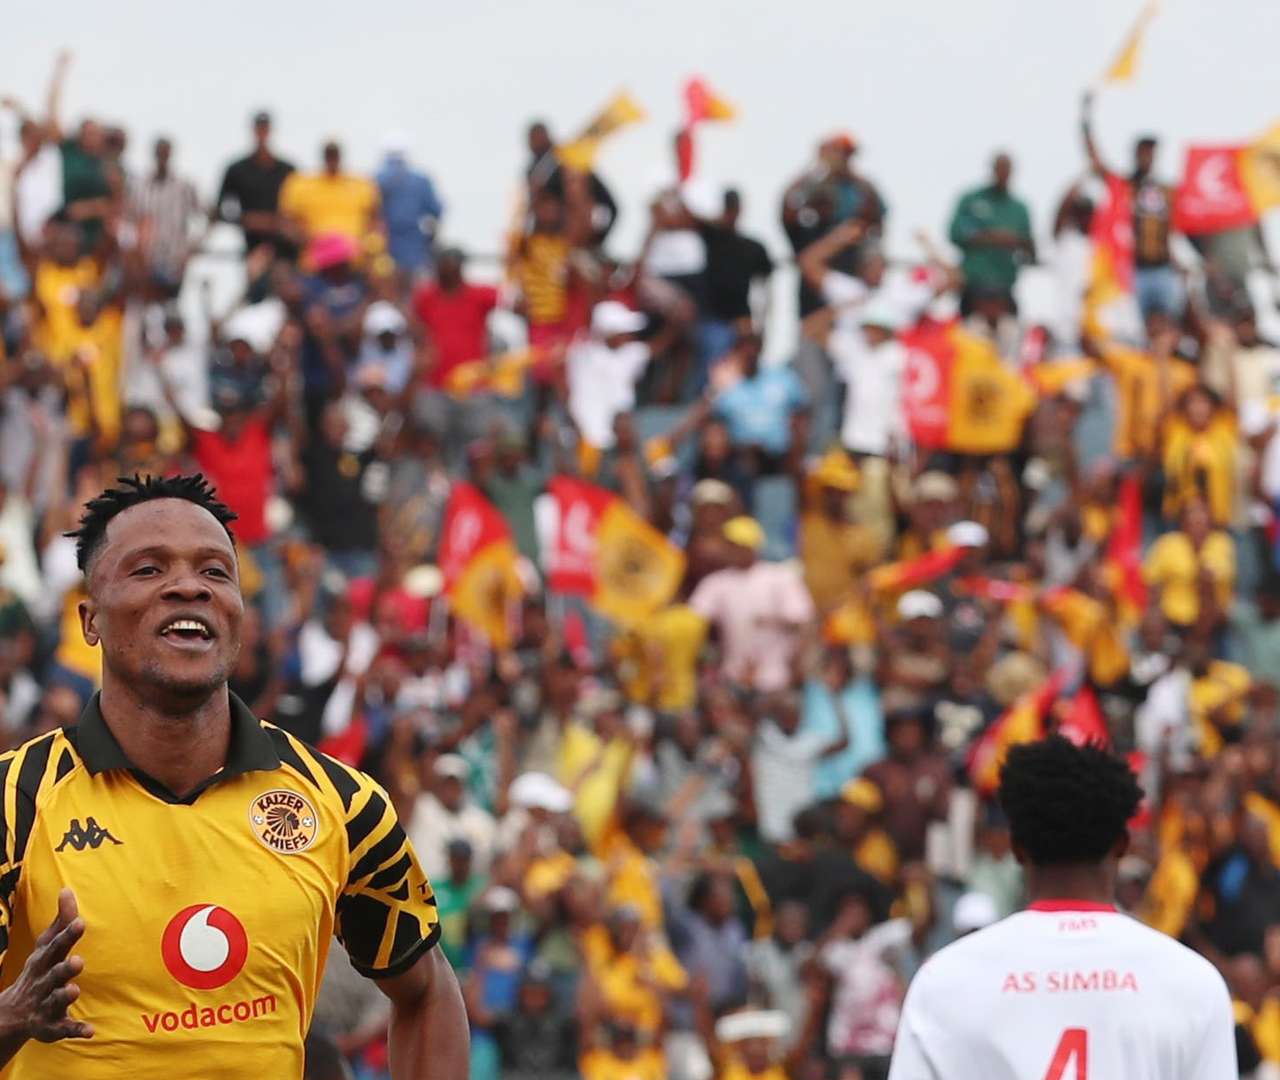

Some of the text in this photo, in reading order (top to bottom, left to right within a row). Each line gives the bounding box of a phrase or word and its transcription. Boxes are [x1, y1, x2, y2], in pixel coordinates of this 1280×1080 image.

[257, 794, 304, 813] KAIZER
[262, 831, 309, 850] CHIEFS
[1002, 969, 1139, 993] AS SIMBA
[141, 993, 277, 1033] vodacom
